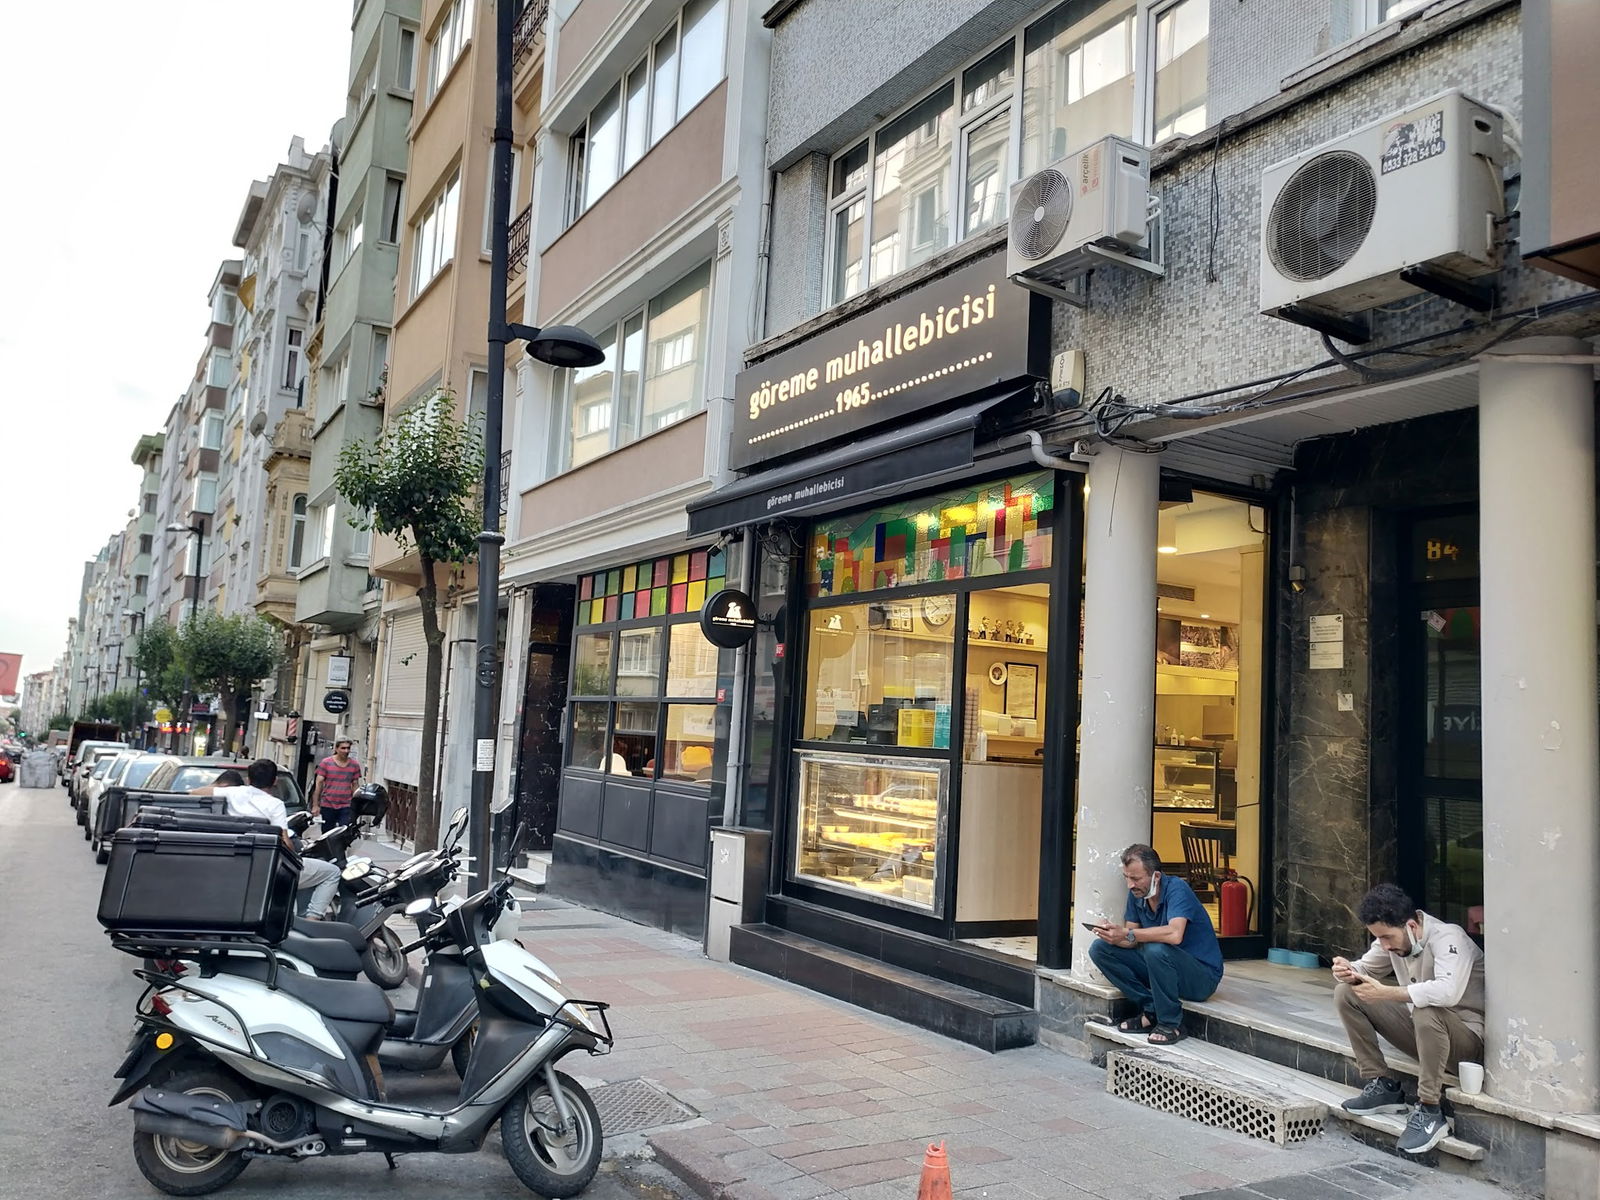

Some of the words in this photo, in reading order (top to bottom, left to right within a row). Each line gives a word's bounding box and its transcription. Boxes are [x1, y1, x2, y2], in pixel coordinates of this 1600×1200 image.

[748, 367, 820, 420] göreme
[825, 283, 996, 384] muhallebicisi
[835, 382, 871, 414] 1965
[766, 493, 793, 510] göreme
[794, 475, 845, 500] muhallebicisi
